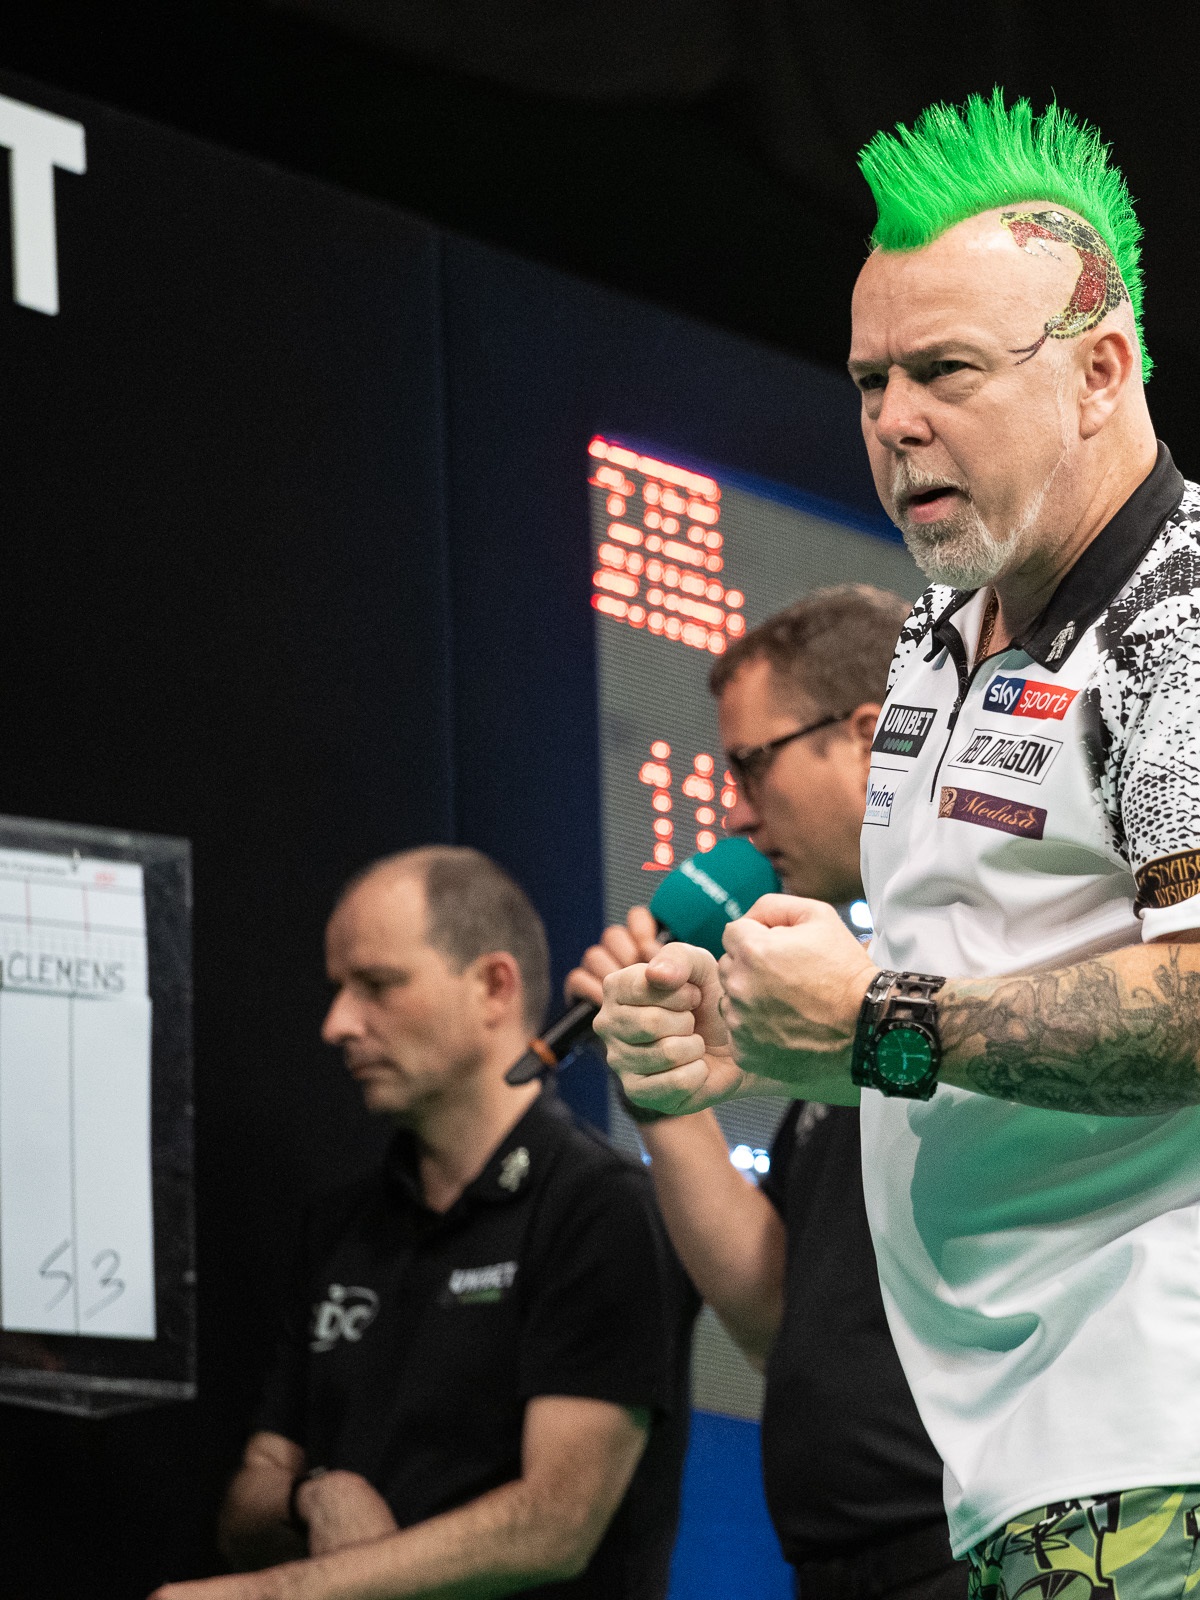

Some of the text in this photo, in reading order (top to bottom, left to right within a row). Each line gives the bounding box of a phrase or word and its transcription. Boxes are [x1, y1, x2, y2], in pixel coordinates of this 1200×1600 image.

[0, 94, 87, 316] T
[988, 680, 1068, 713] sky sport
[884, 707, 934, 737] UNIBET
[956, 735, 1054, 778] RED DRAGON
[959, 793, 1038, 830] Medusa
[7, 950, 125, 993] CLEMENS
